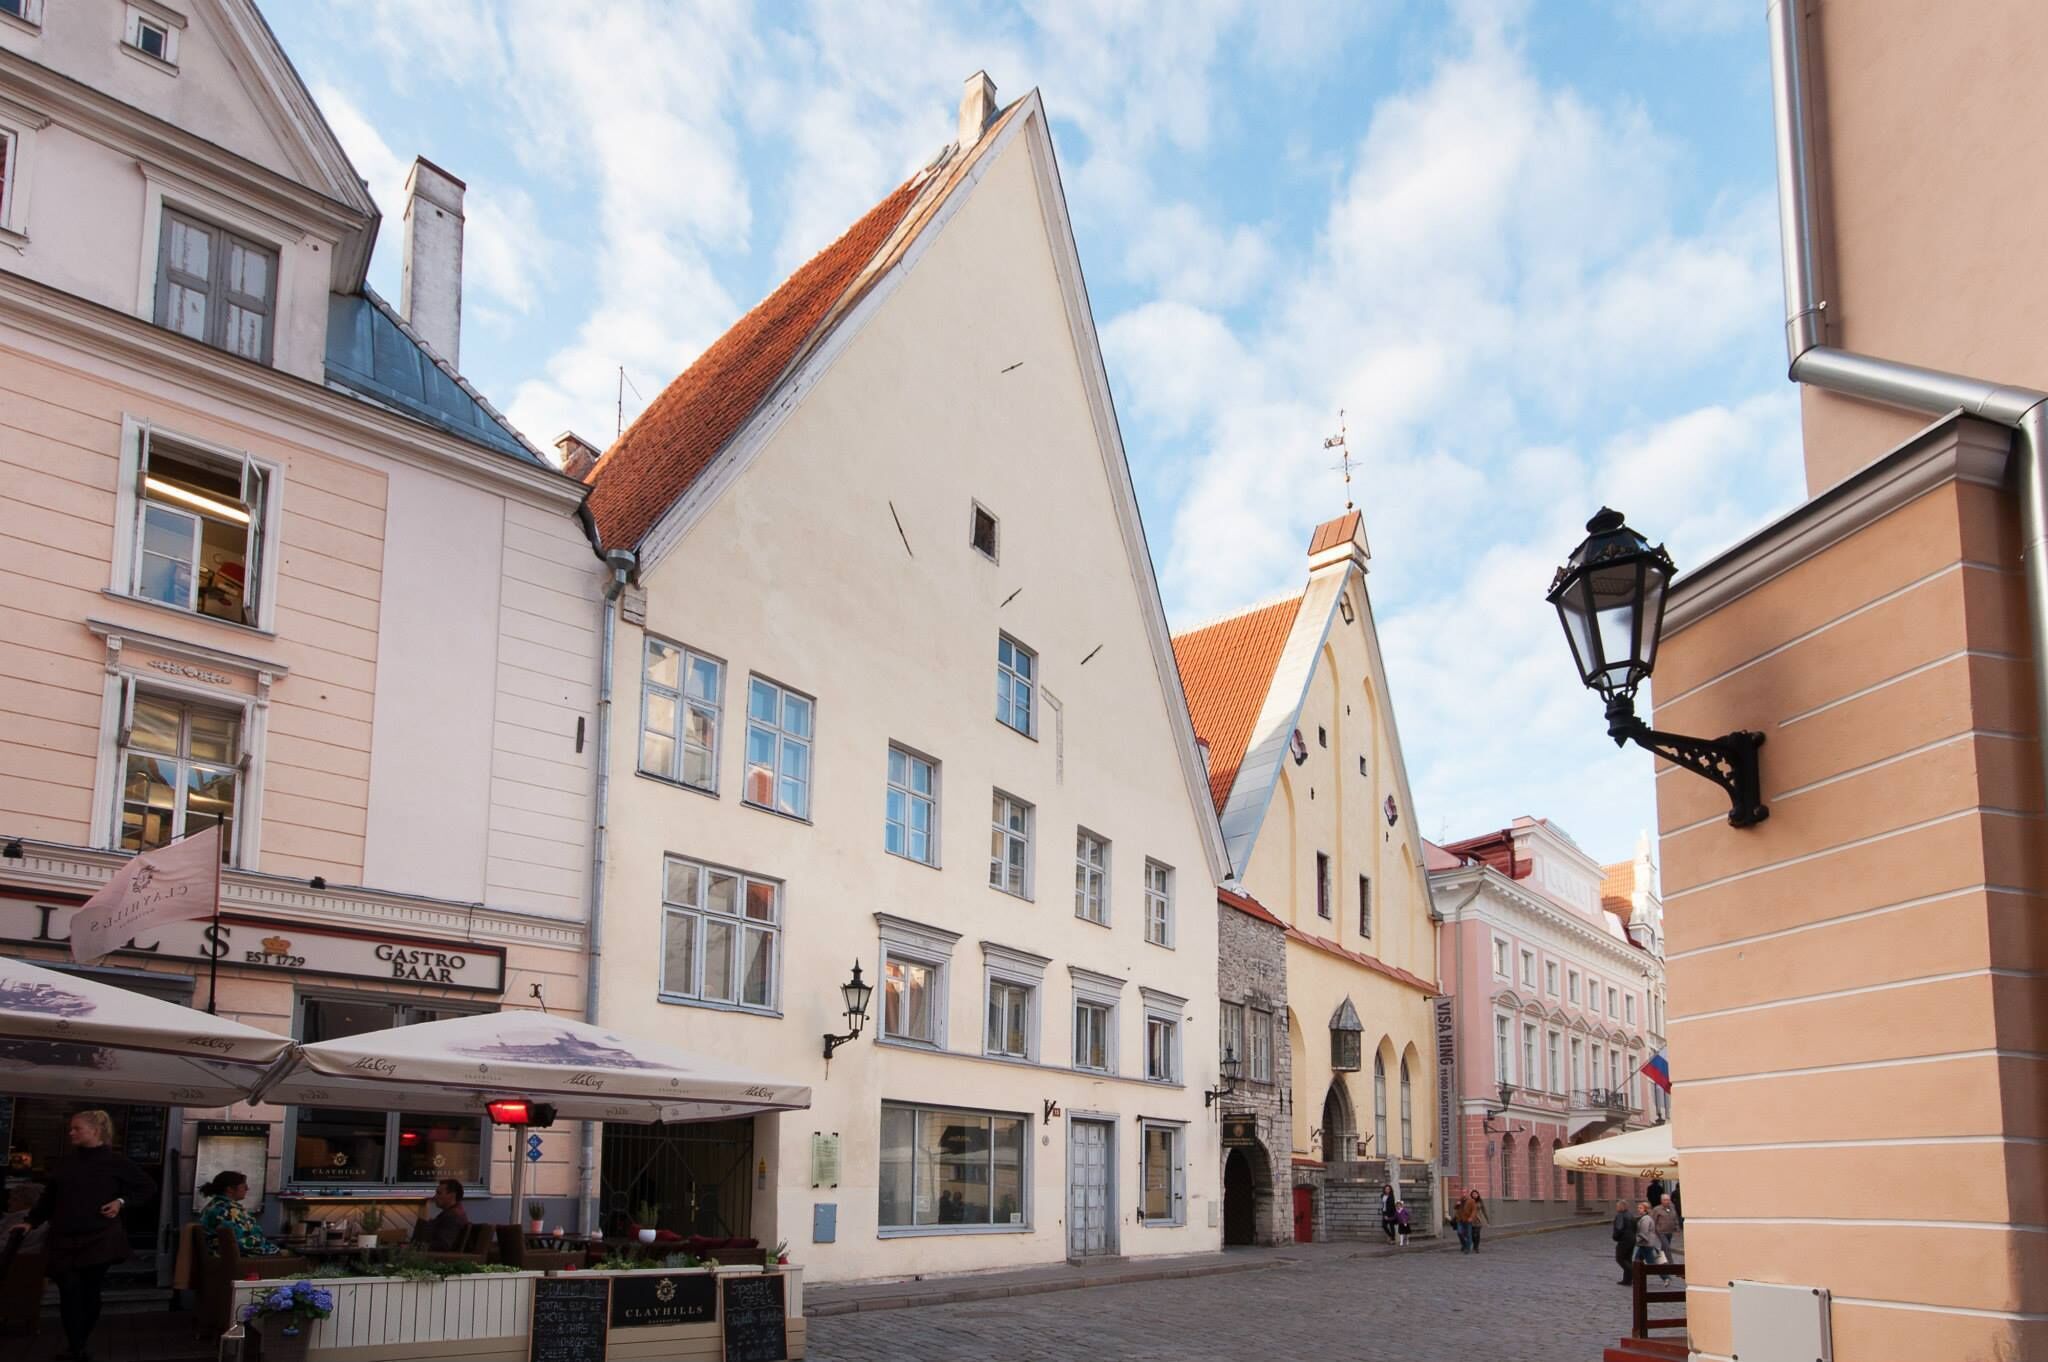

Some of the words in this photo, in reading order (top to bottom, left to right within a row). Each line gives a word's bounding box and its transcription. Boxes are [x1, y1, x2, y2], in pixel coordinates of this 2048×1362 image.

[245, 951, 270, 965] EST
[275, 953, 305, 967] 1729
[375, 944, 466, 969] GASTRO
[392, 962, 454, 983] BAAR
[1437, 1002, 1451, 1033] VISA
[1439, 1034, 1454, 1065] HING
[625, 1305, 704, 1318] CLAYHILLS
